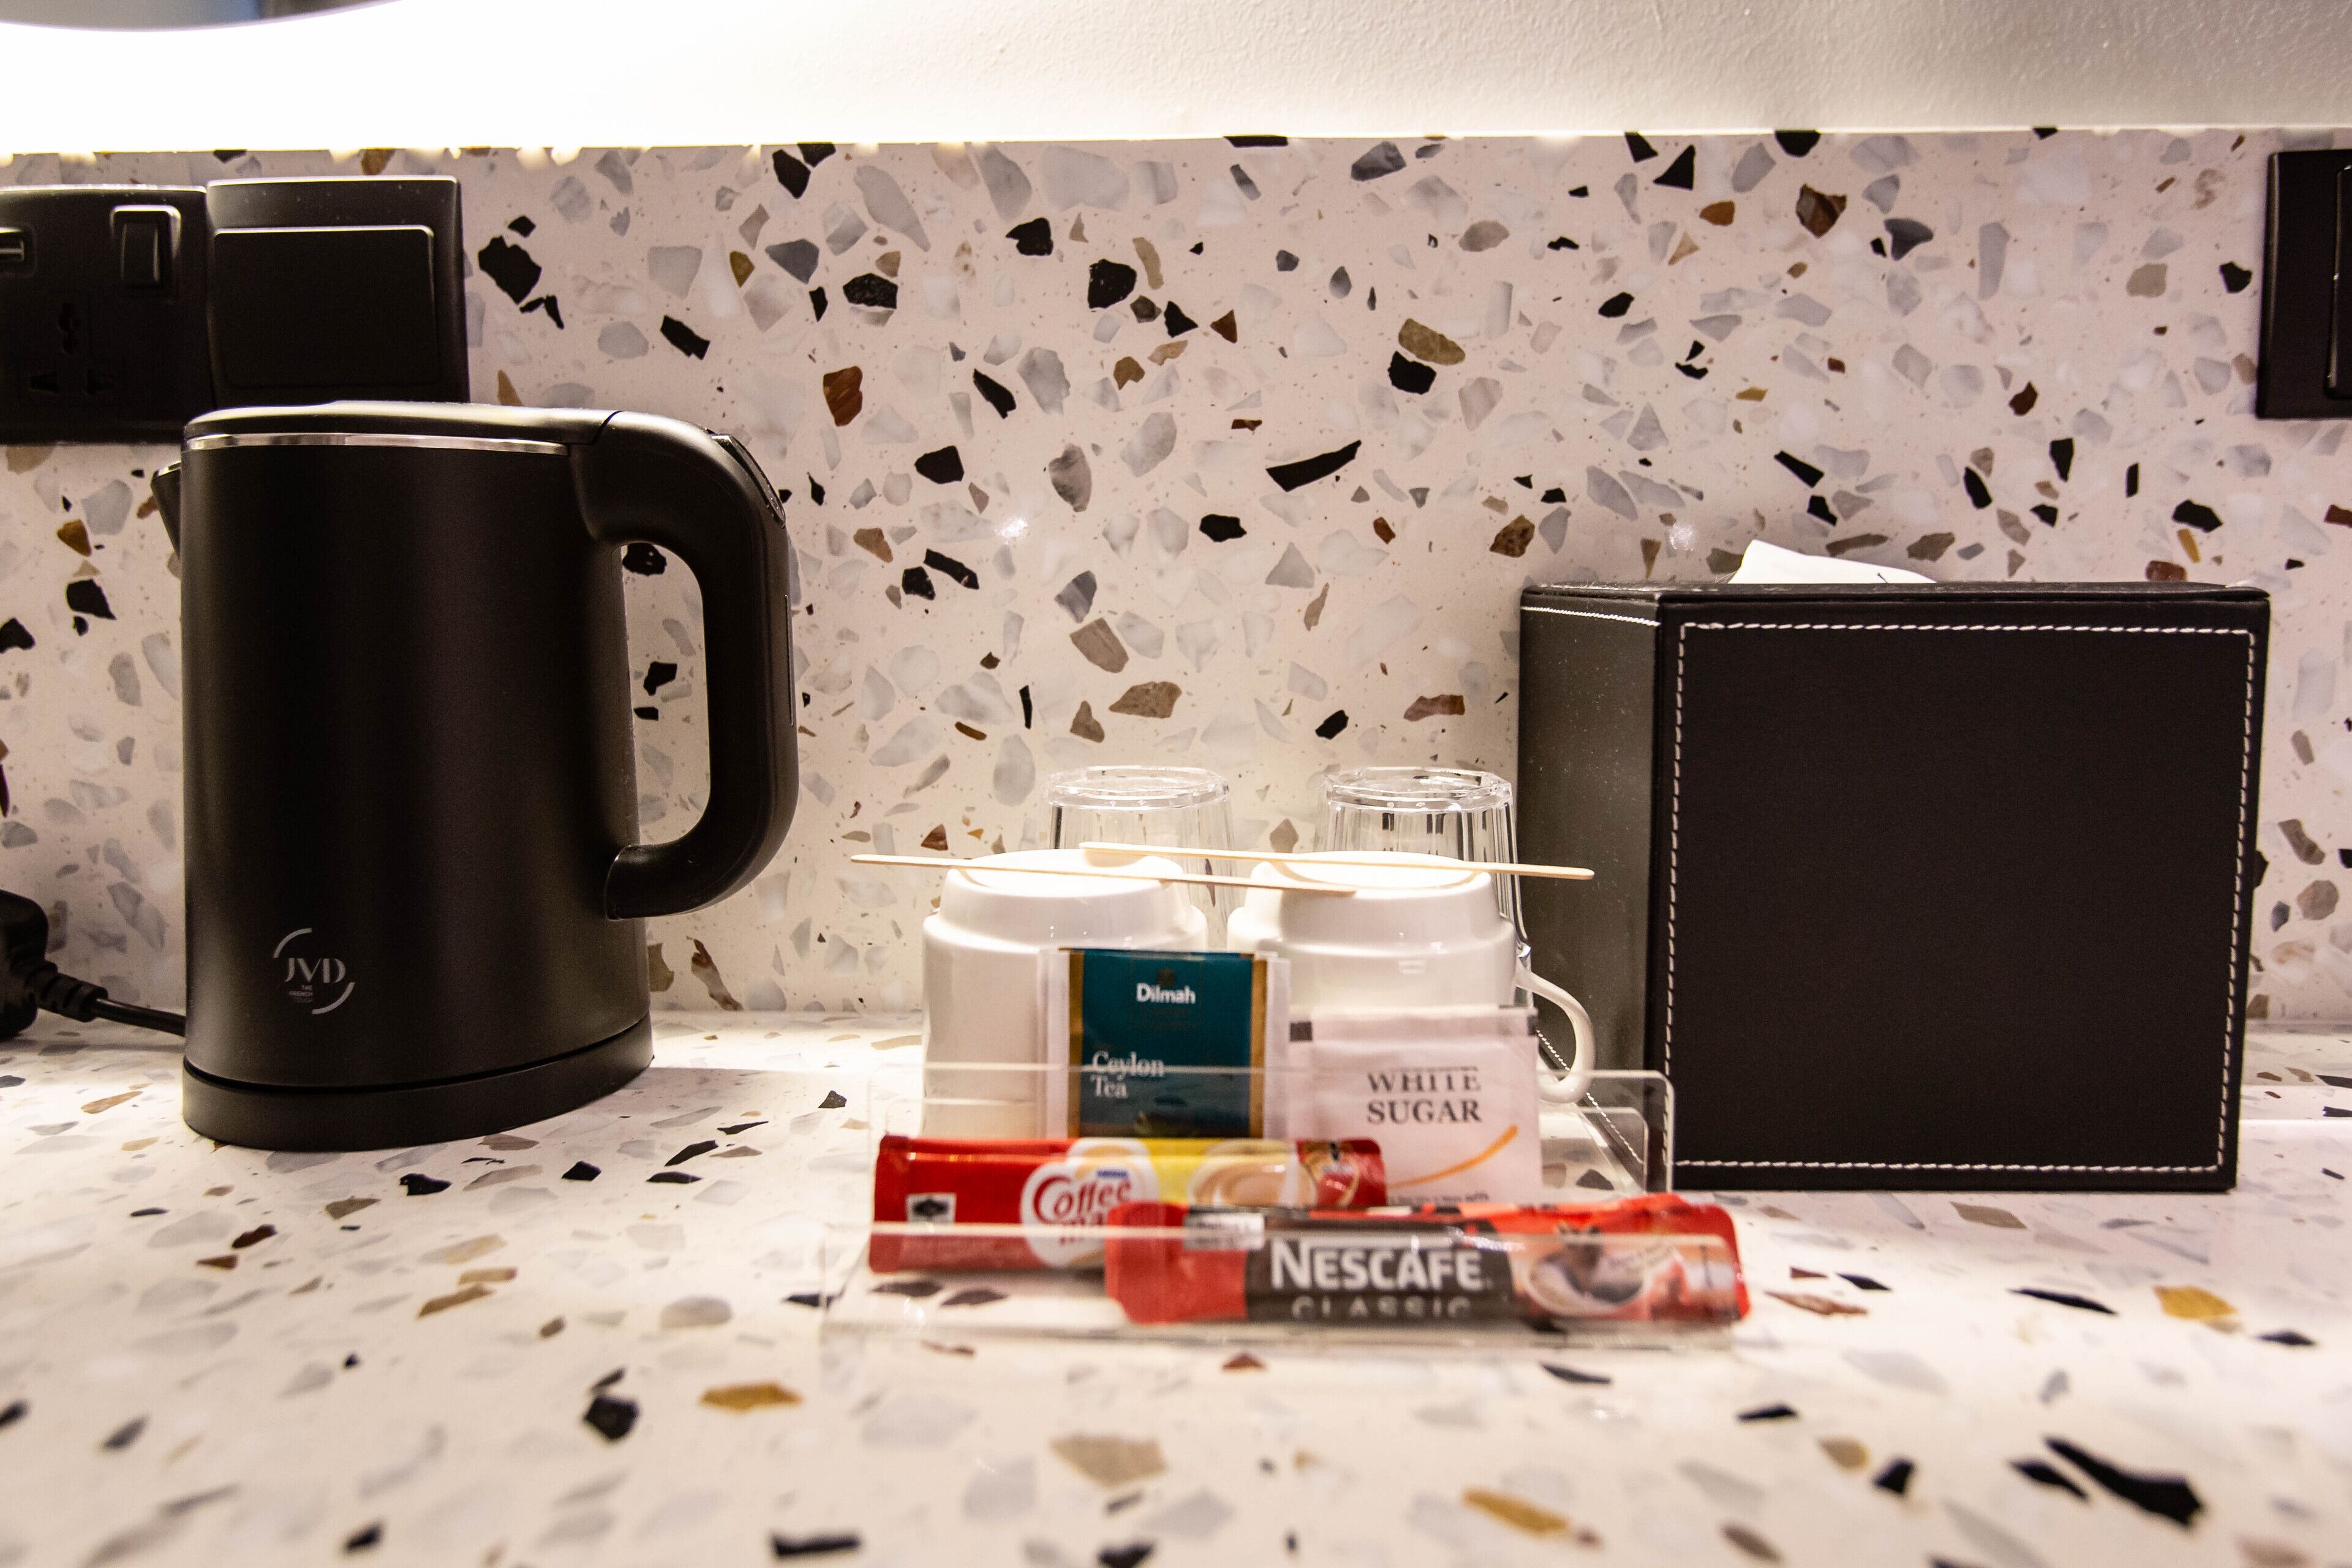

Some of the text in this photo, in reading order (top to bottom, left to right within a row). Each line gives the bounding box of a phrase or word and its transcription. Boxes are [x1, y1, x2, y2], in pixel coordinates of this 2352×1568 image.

[284, 957, 347, 983] JVD
[1136, 982, 1196, 1005] Dilmah
[1092, 1050, 1164, 1081] Ceylon
[1090, 1074, 1128, 1098] Tea
[1366, 1067, 1481, 1093] WHITE
[1366, 1098, 1481, 1125] SUGAR
[1033, 1174, 1132, 1225] Coffee
